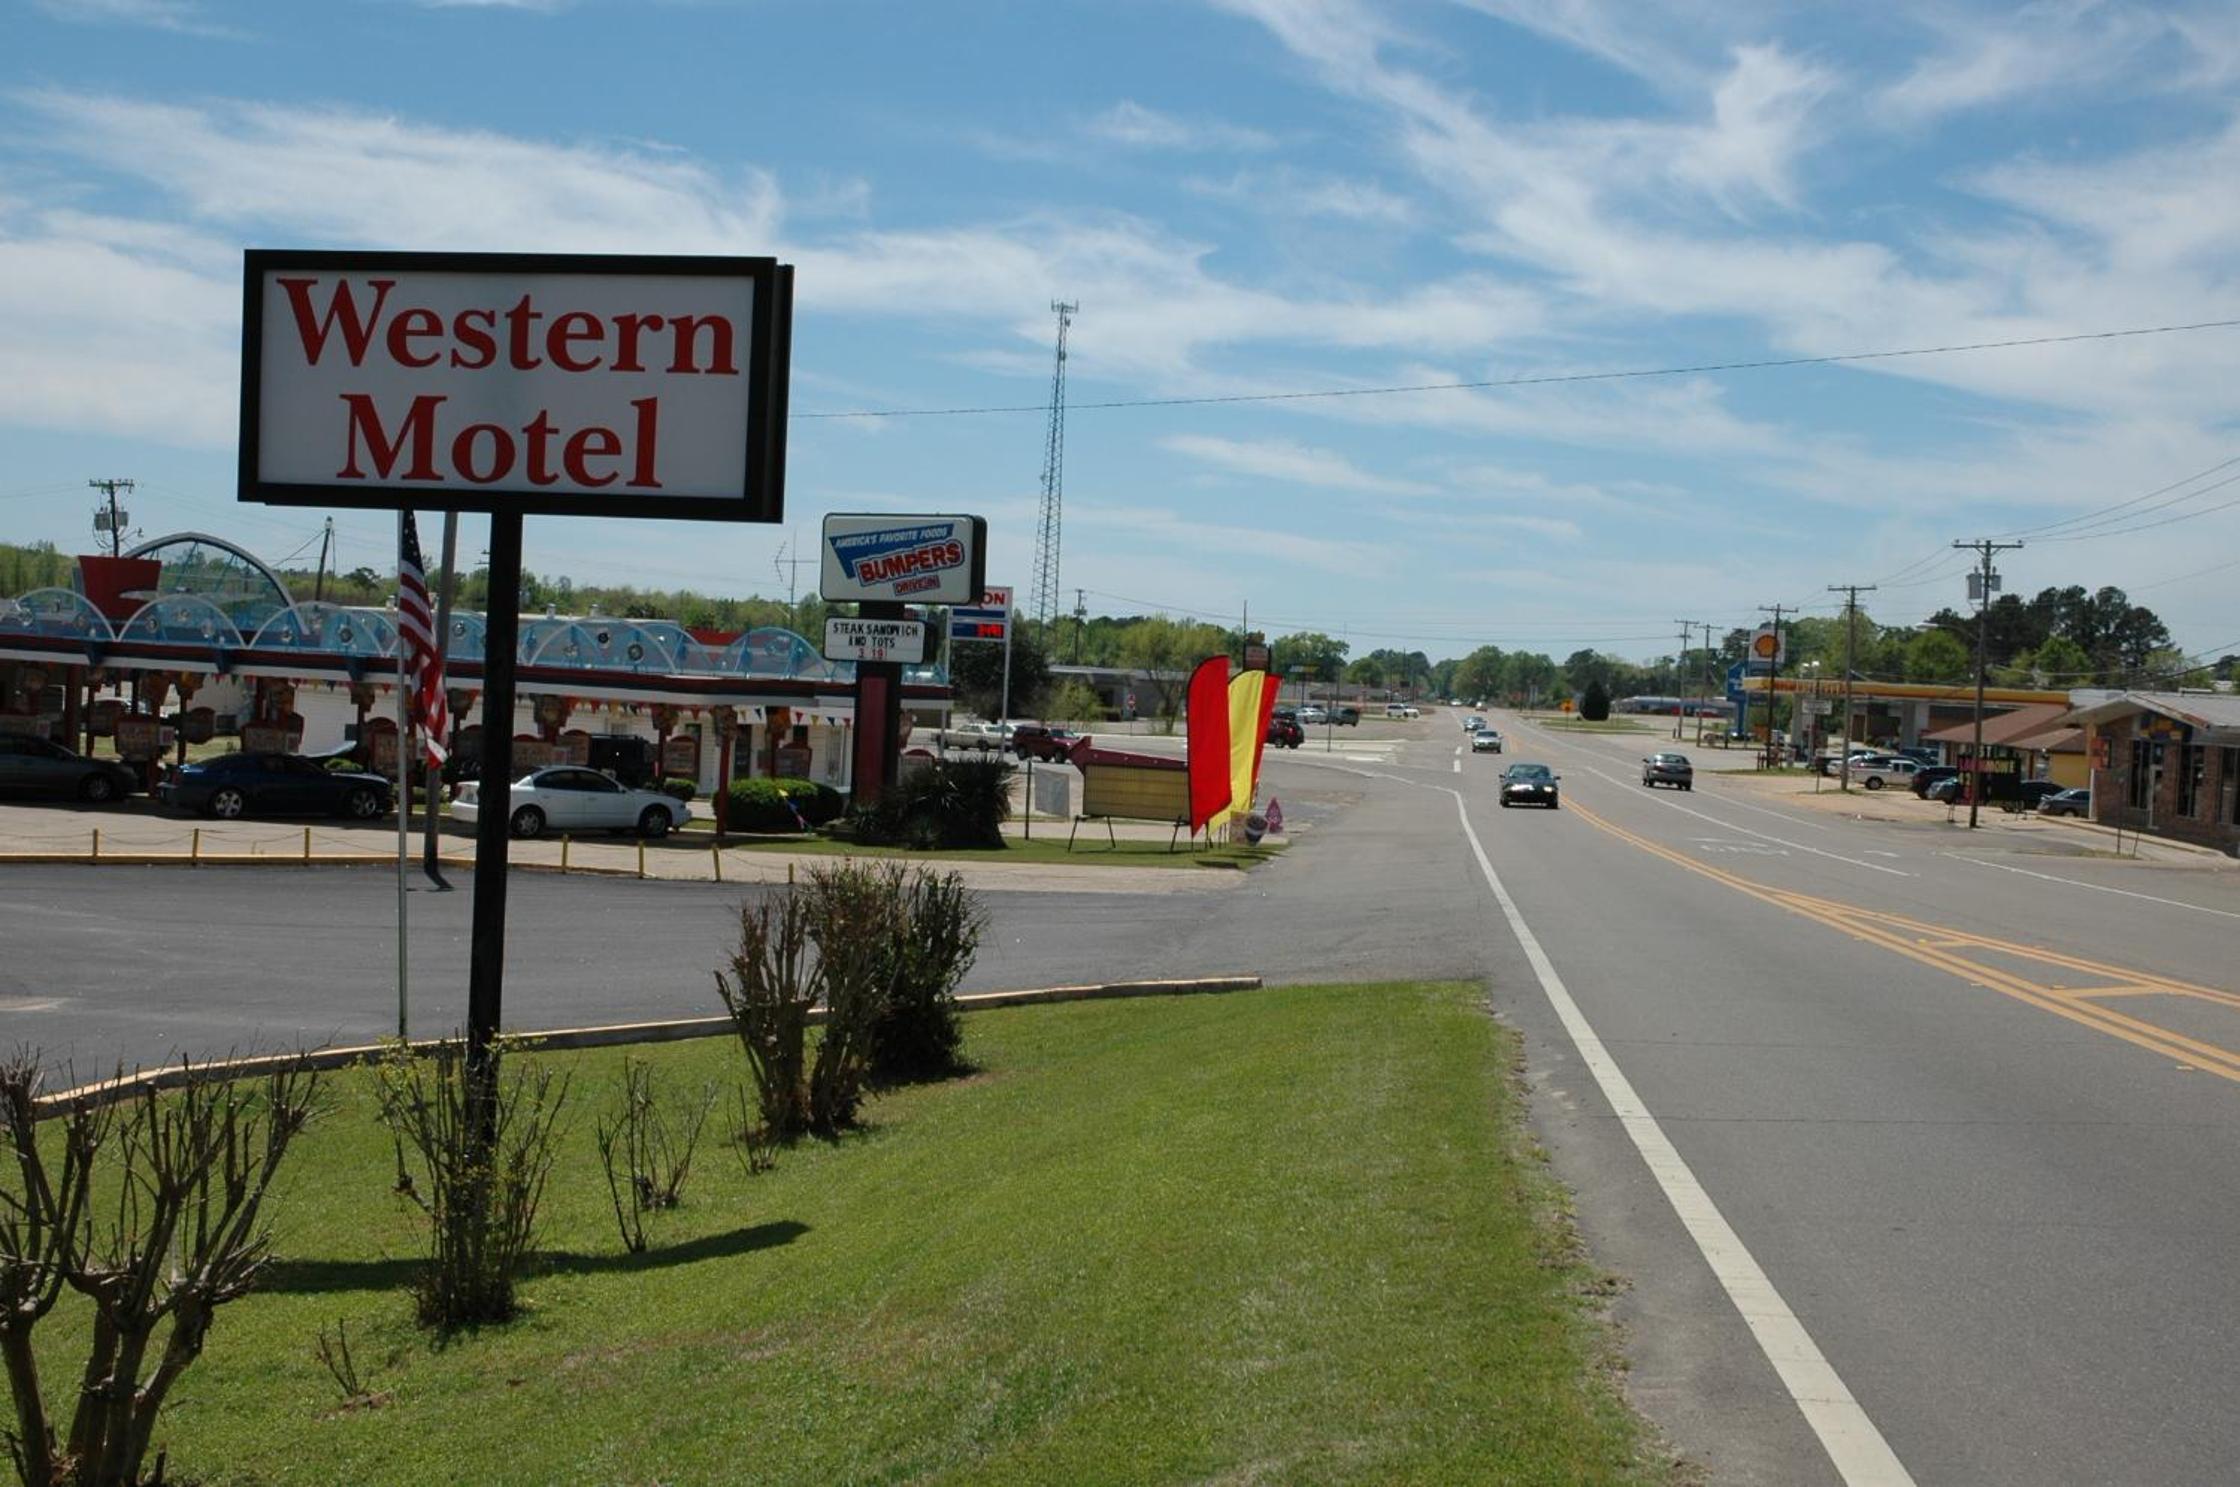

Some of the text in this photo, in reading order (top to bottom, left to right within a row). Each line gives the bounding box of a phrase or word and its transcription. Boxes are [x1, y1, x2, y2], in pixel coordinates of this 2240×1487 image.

[276, 277, 739, 376] Western
[336, 393, 663, 489] Motel
[859, 542, 961, 583] BUMPERS
[833, 622, 918, 637] STEAK SANDWICH
[849, 635, 896, 649] AND TOTS
